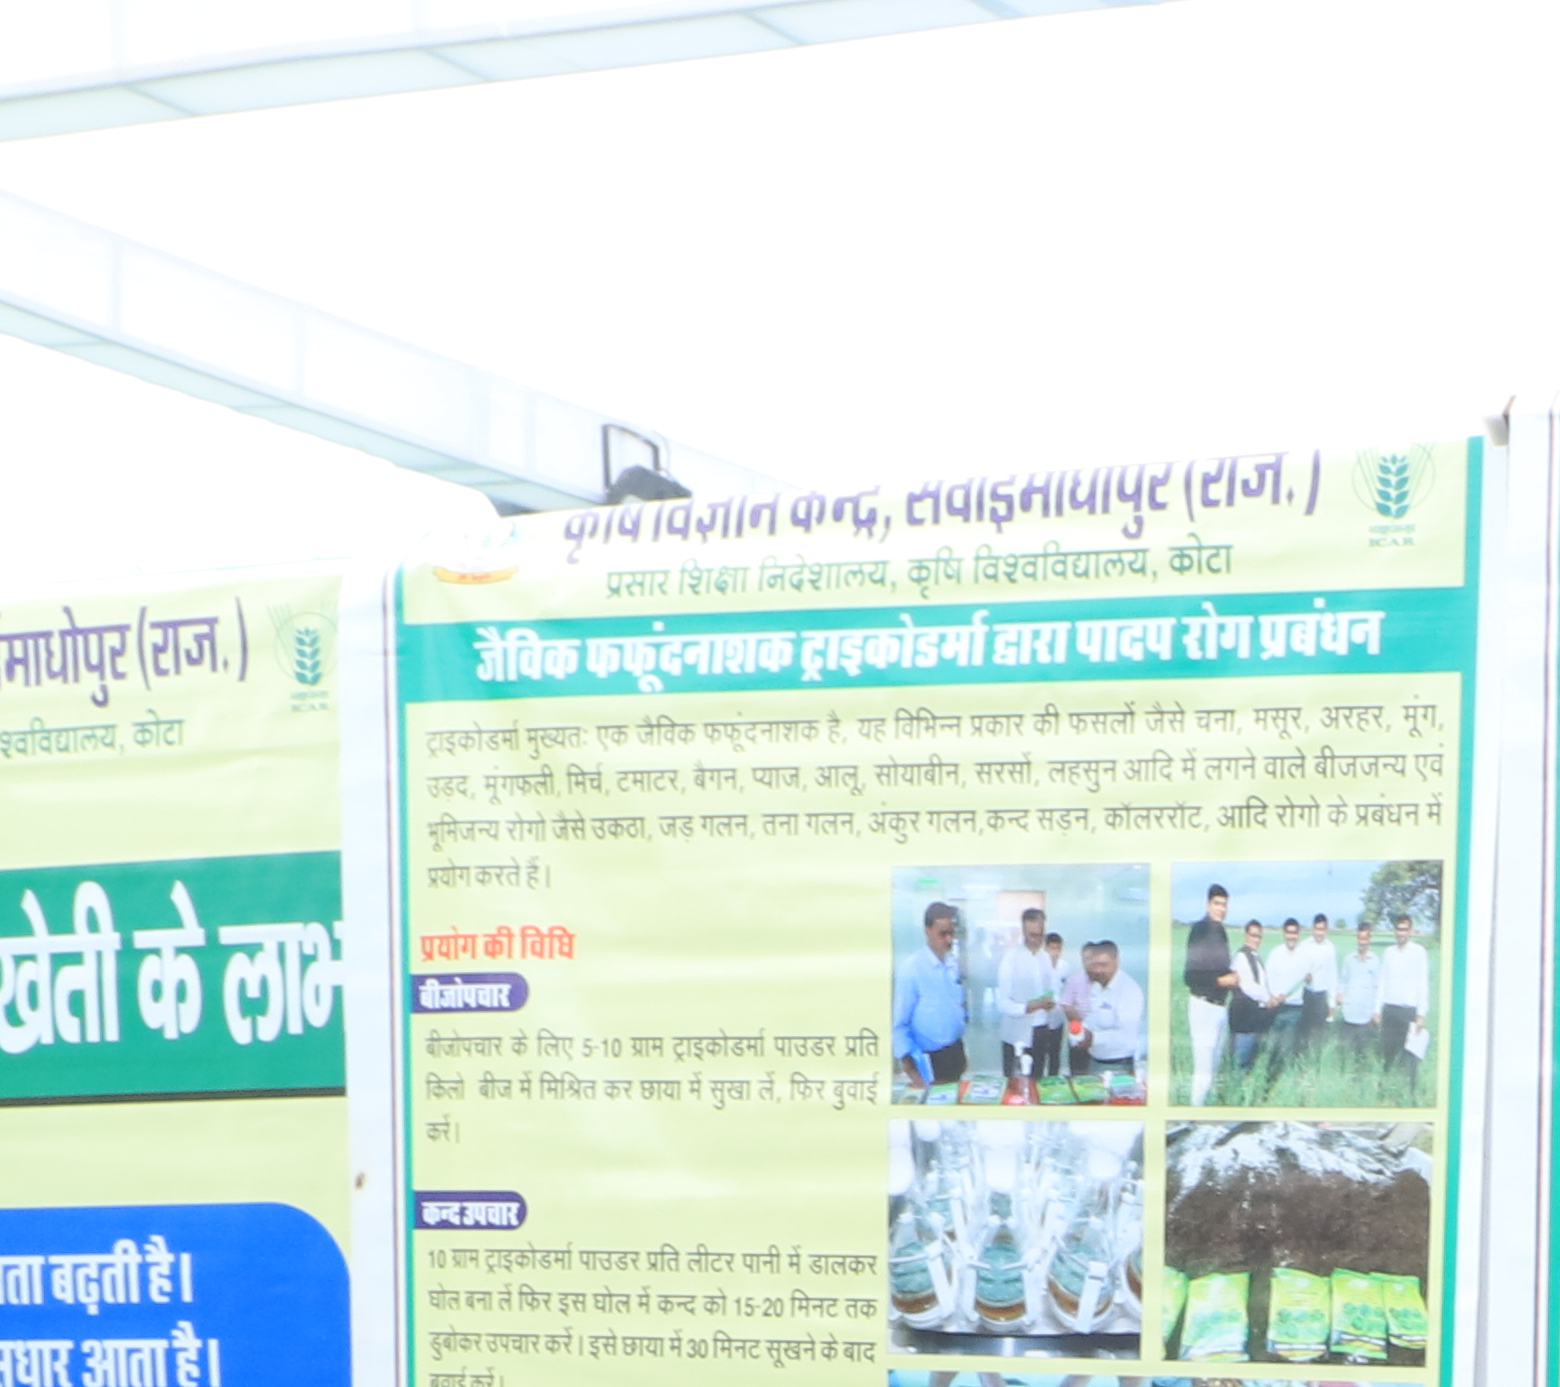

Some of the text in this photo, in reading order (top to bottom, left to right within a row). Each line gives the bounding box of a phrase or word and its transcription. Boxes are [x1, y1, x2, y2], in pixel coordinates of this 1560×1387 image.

[137, 598, 249, 691] (राज.)
[474, 601, 1385, 690] जैविक फफूंदनाशक ट्राइकोडर्मा द्वारा पादप रोग प्रबंधन
[133, 880, 205, 1039] के
[420, 925, 577, 963] प्रयोग की विधि
[418, 977, 512, 1009] बीजोपचार
[47, 1238, 144, 1316] बढ़ती
[143, 1234, 193, 1304] है।
